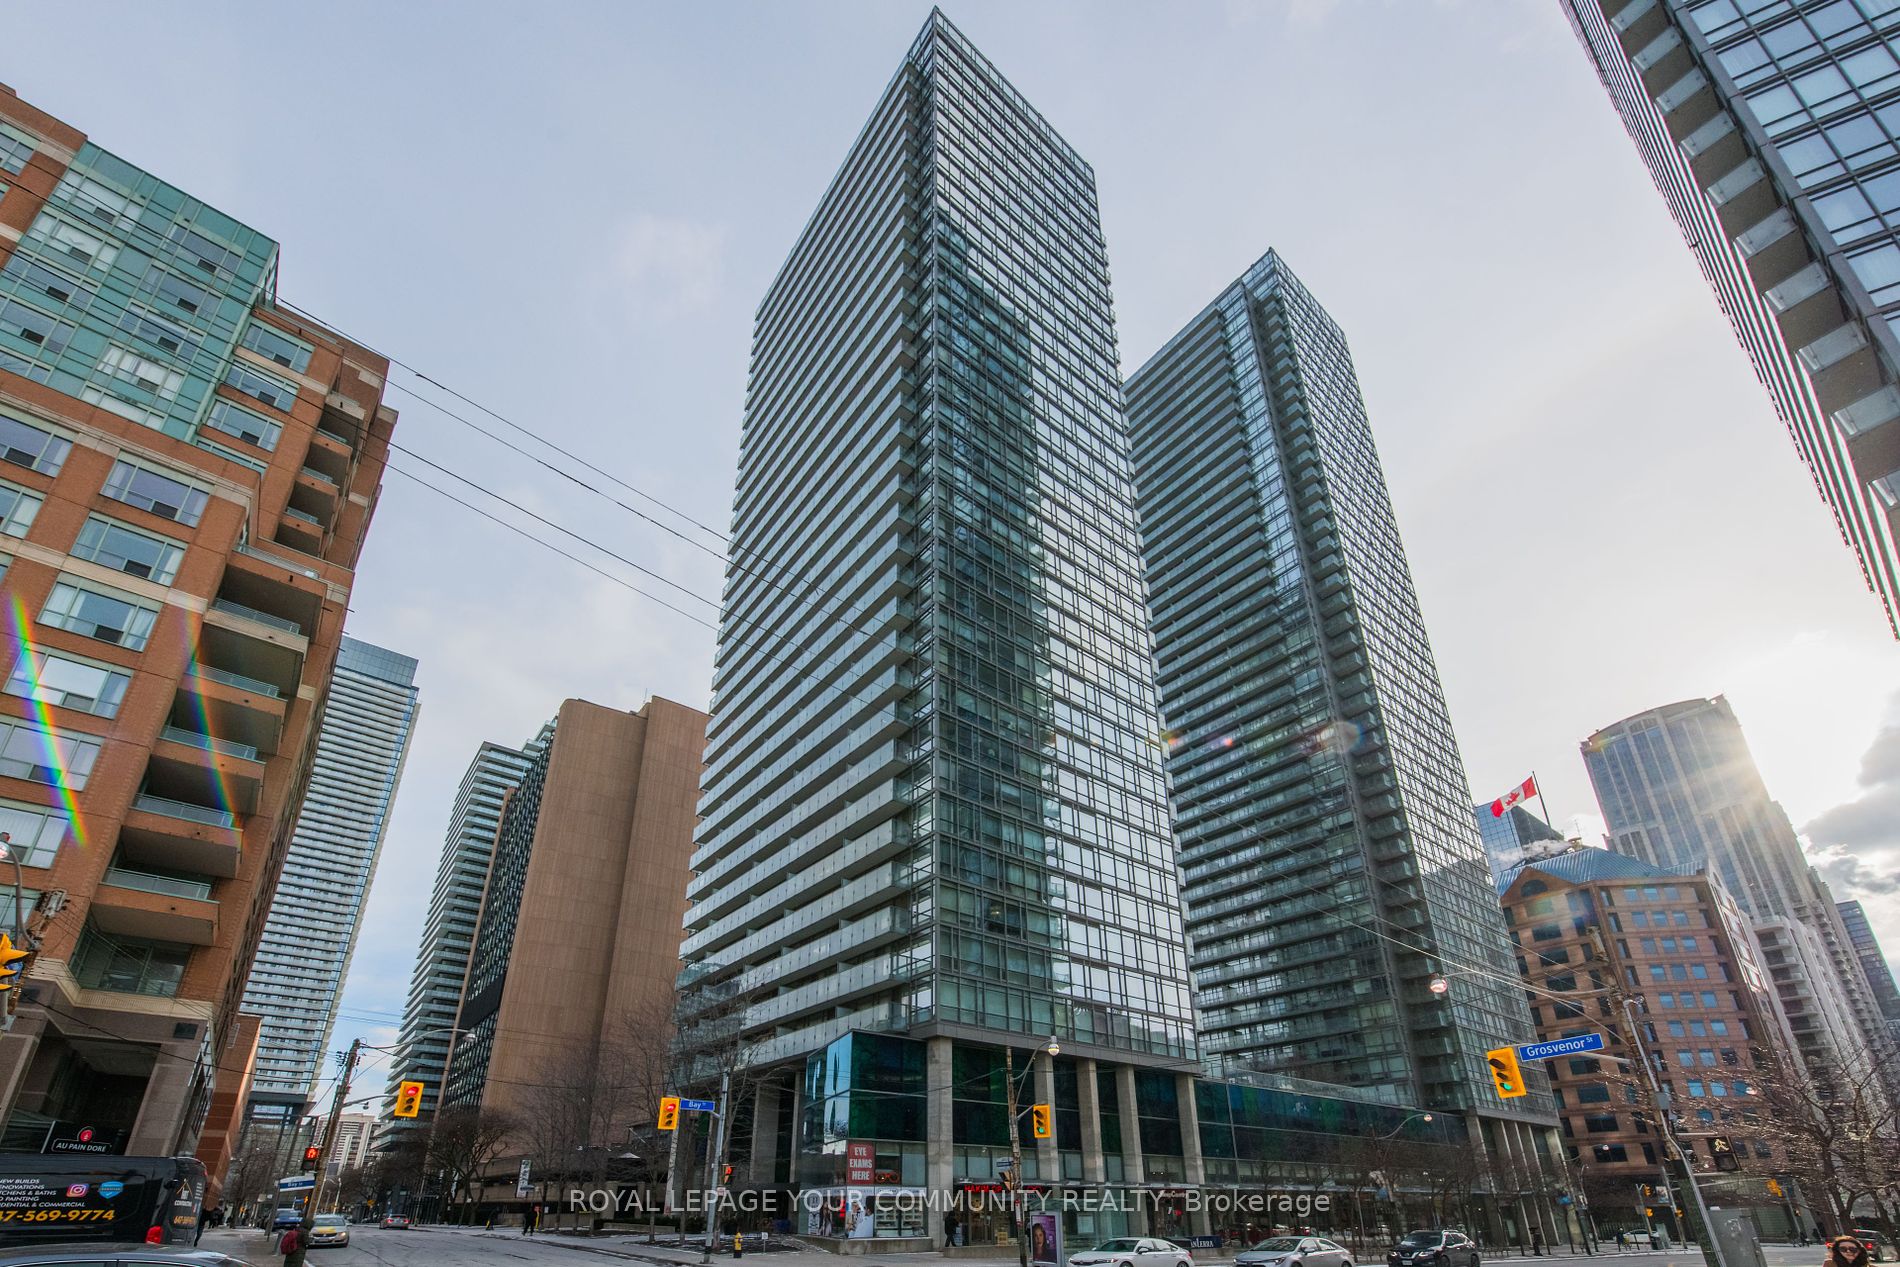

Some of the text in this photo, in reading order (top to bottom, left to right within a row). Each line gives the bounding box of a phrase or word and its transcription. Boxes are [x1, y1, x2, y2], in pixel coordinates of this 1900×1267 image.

[1527, 1040, 1585, 1056] Grosvenor
[688, 1100, 701, 1110] Bay
[68, 1143, 87, 1151] PAIN
[854, 1146, 867, 1156] EYE
[849, 1158, 873, 1169] EXAMS
[851, 1170, 870, 1181] HERE
